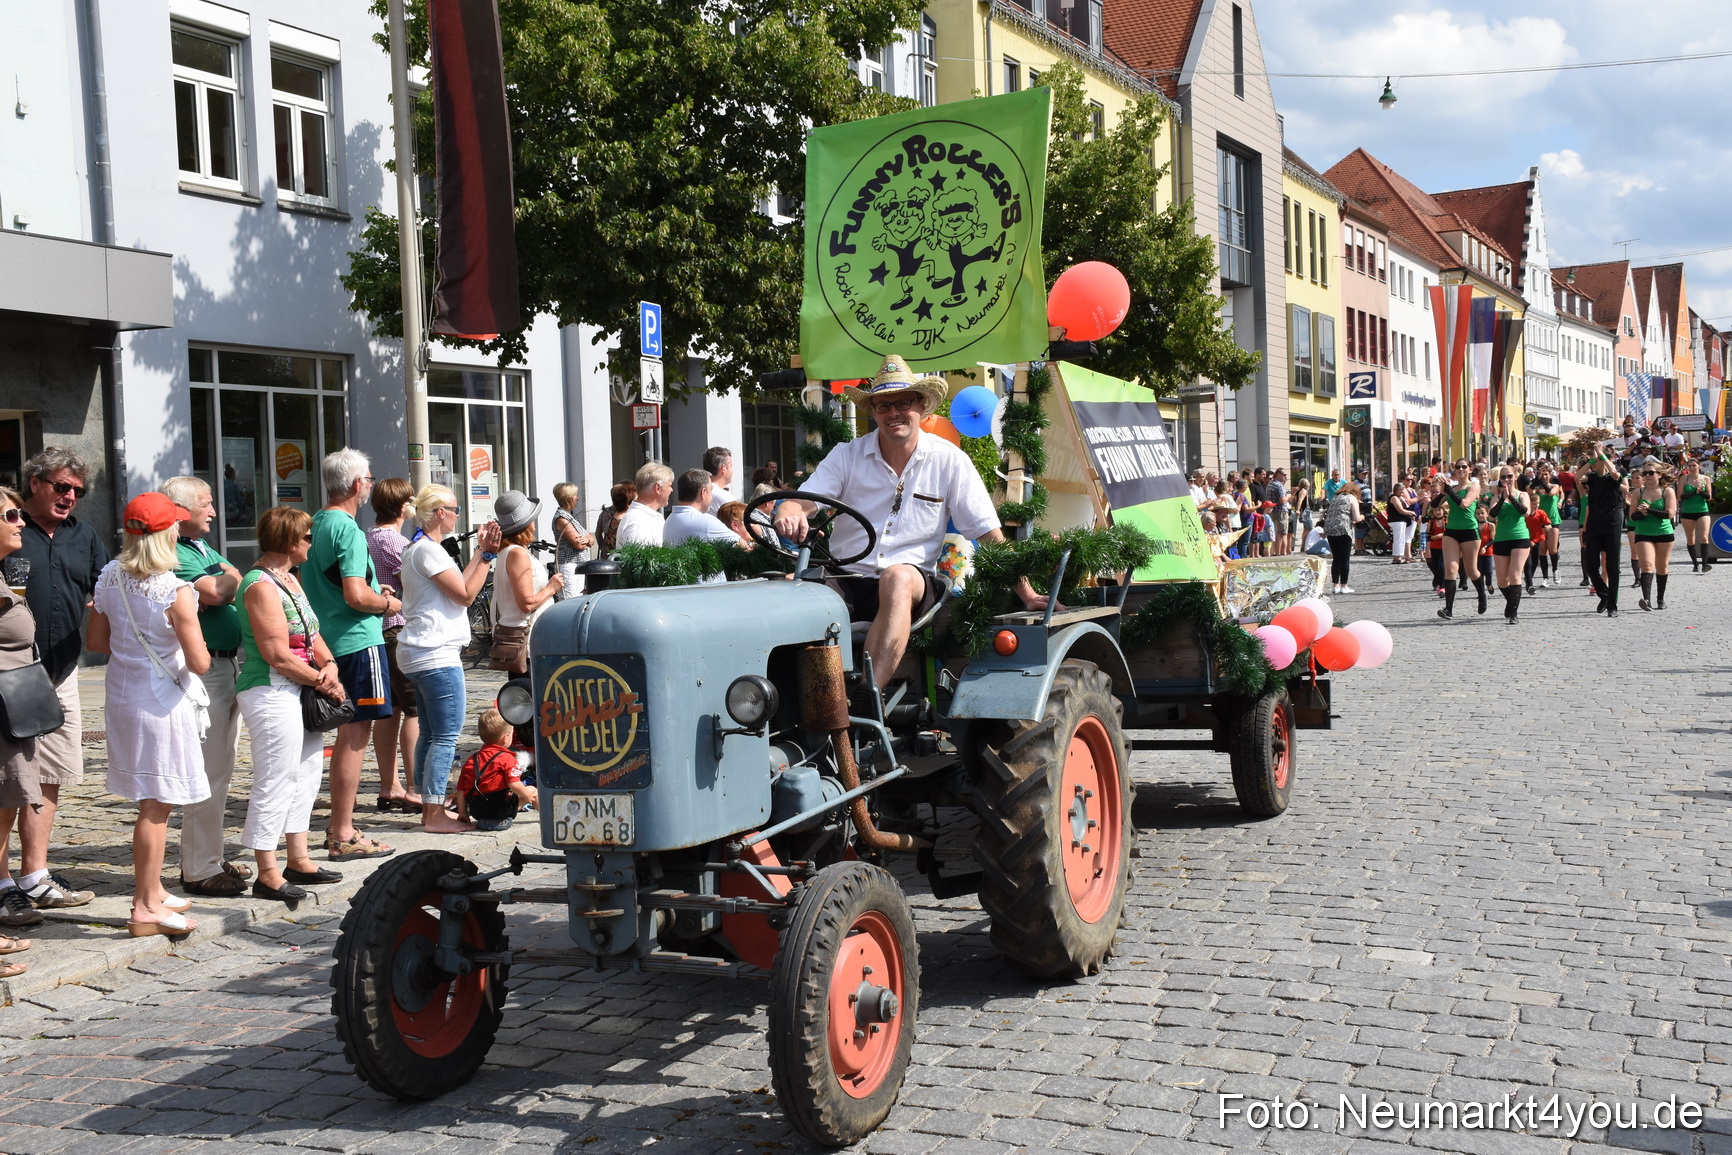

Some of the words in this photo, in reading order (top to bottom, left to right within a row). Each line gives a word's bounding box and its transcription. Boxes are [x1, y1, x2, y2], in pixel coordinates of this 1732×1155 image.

[645, 309, 657, 349] P
[854, 302, 896, 344] Roll-Club
[911, 326, 945, 351] DJK
[957, 273, 1008, 333] Neumarkt
[1094, 445, 1143, 484] FUNNY
[1134, 443, 1181, 478] ROLLERS
[539, 690, 644, 738] Eicher
[584, 797, 616, 818] NM
[555, 820, 586, 842] DC
[602, 820, 630, 842] 68
